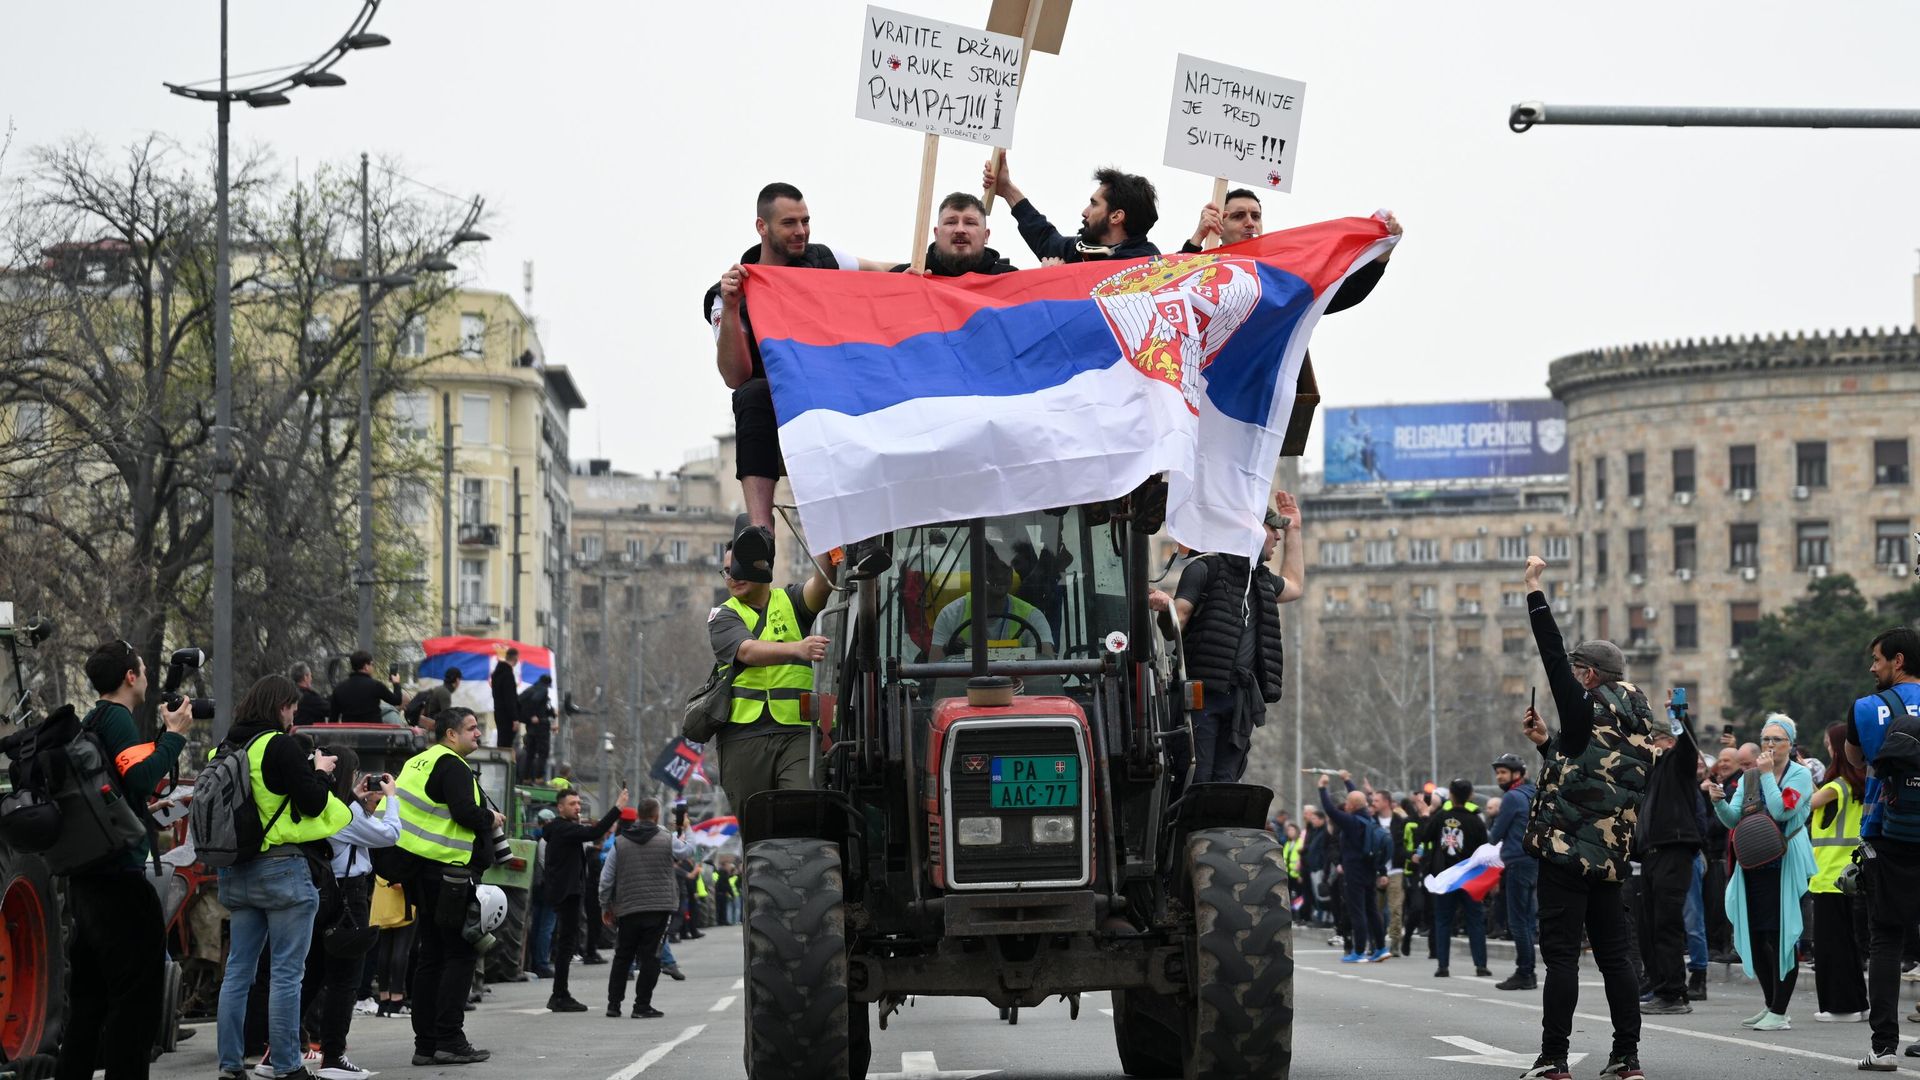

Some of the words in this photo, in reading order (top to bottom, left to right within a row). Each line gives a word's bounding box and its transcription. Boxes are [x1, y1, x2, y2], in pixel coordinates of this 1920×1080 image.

[871, 16, 943, 49] VRATITE
[957, 37, 1019, 67] DRŽAVU
[872, 49, 882, 69] U
[907, 55, 954, 81] RUKE
[968, 65, 1019, 88] STRUKE
[868, 74, 988, 130] PUMPAJ!!!
[1184, 70, 1296, 111] NAJTAMNIJE
[1182, 100, 1204, 115] JE
[1222, 103, 1261, 128] PRED
[1394, 424, 1466, 450] BELGRADE
[1467, 422, 1505, 448] OPEN
[1013, 760, 1037, 781] PA
